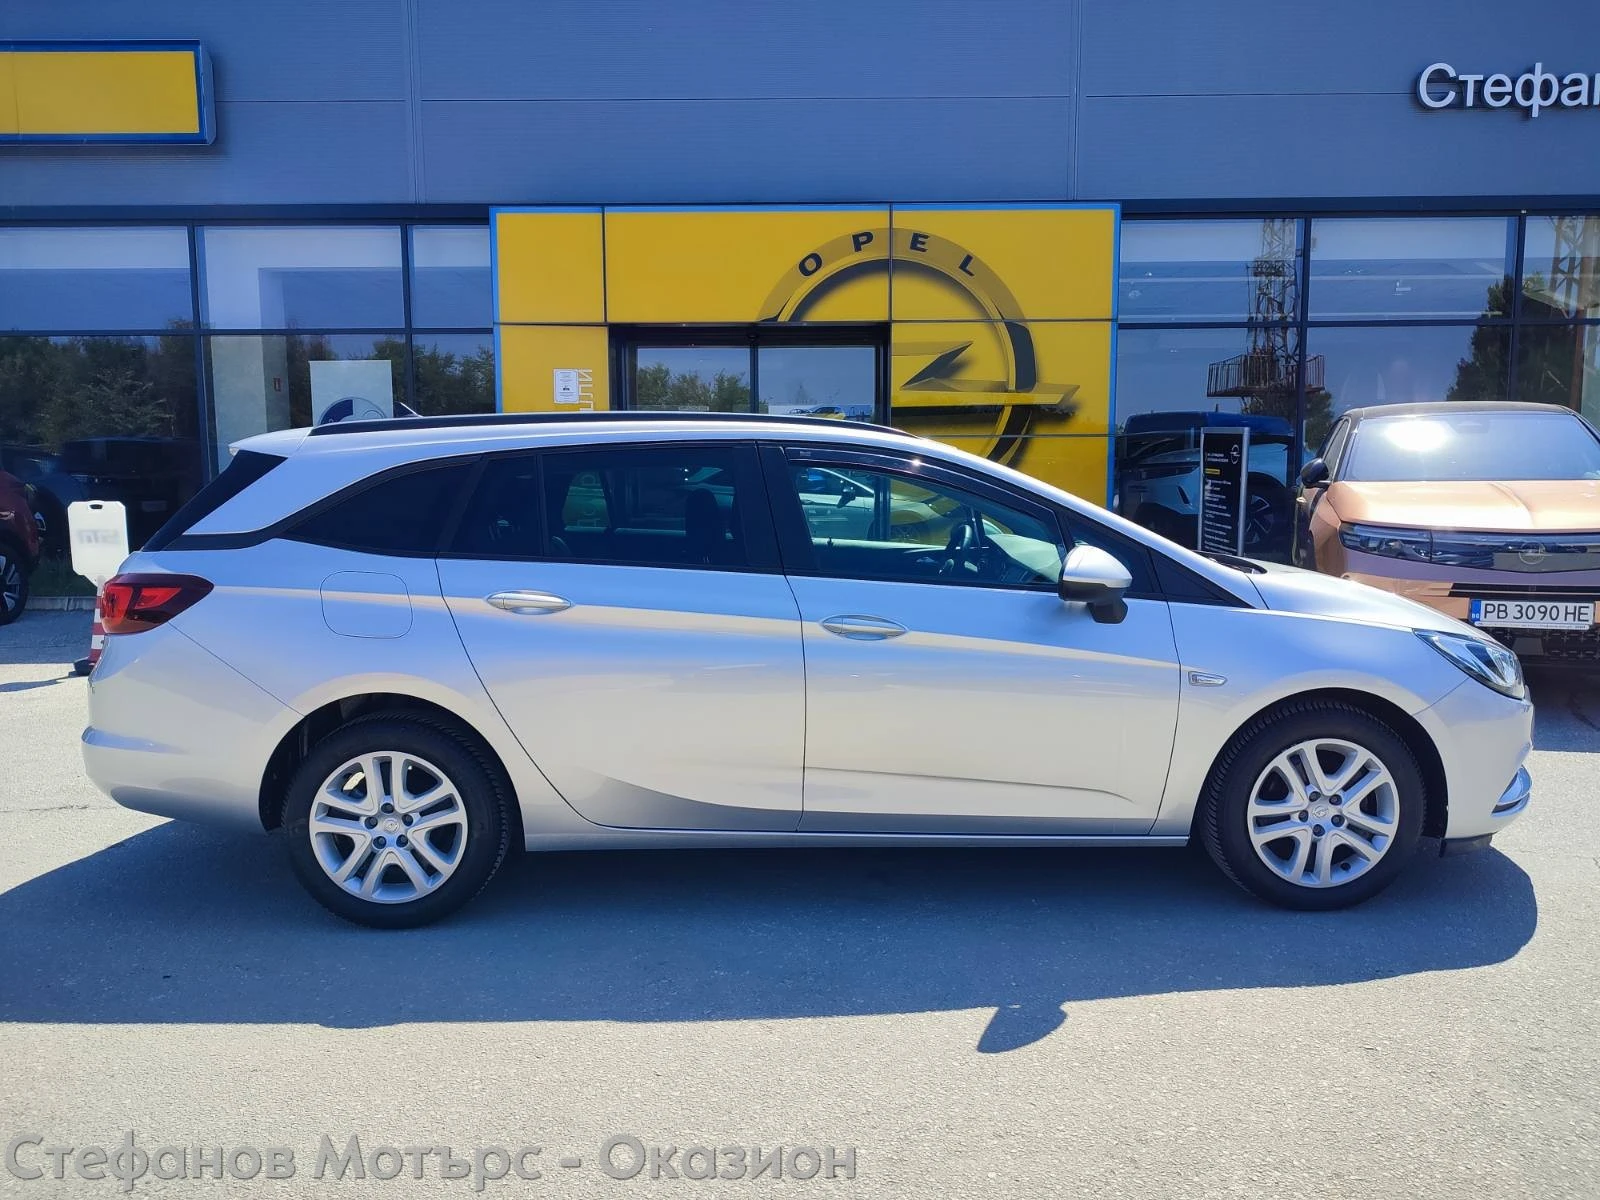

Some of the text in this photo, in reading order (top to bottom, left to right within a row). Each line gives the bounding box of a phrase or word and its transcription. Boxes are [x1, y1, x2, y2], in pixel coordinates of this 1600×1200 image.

[798, 231, 975, 277] OPEL
[1483, 603, 1508, 619] PB
[1512, 604, 1560, 621] 3090
[1564, 605, 1590, 622] HE
